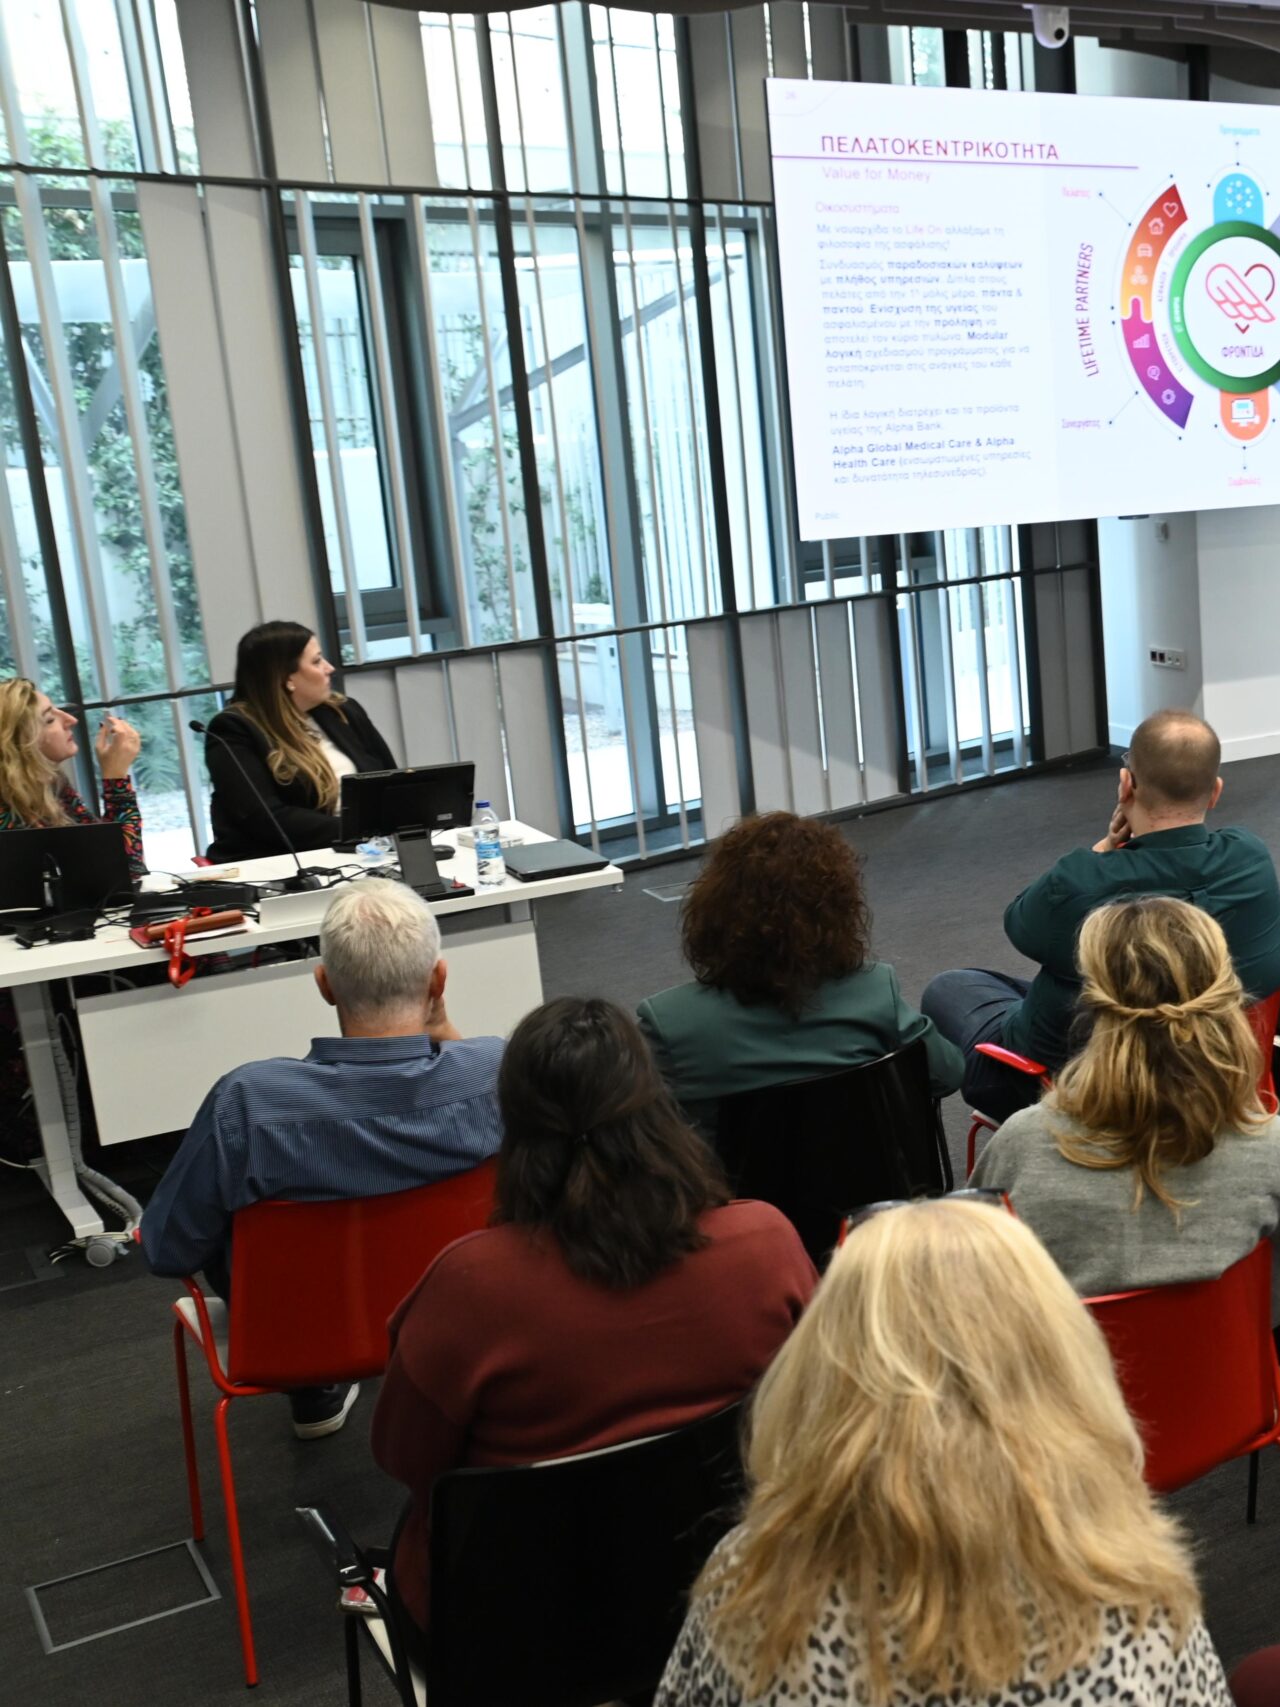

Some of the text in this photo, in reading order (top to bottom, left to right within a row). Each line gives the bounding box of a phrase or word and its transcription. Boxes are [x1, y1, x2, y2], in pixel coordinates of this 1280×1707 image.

[821, 135, 1059, 160] ΠΕΛΑΤΟΚΕΝΤΡΙΚΟΤΗΤΑ
[822, 166, 931, 183] Value for Money
[906, 225, 924, 235] Life
[928, 225, 944, 235] On
[1075, 242, 1100, 377] LIFETIME PARTNERS
[967, 331, 1008, 341] Modular
[885, 423, 914, 434] Alpha
[832, 436, 1016, 457] Alpha Global Medical Care & Alpha
[833, 458, 869, 470] Health
[871, 457, 897, 468] Care
